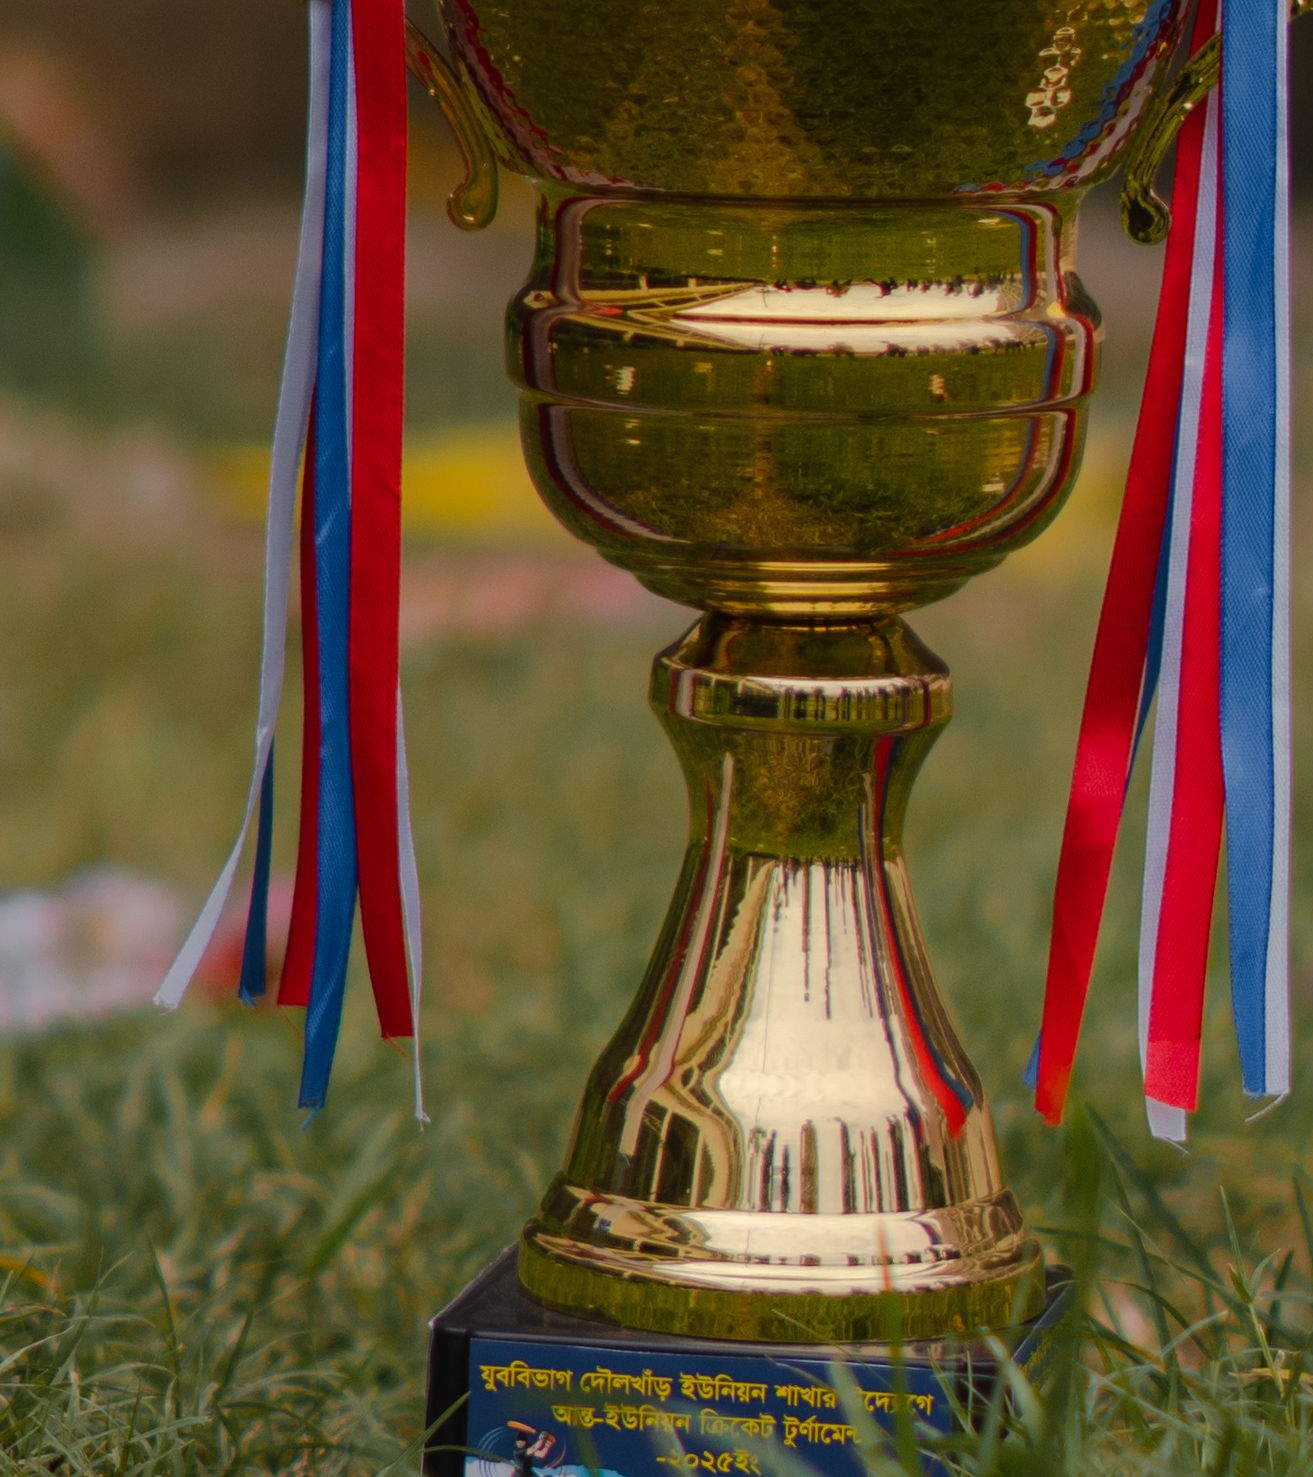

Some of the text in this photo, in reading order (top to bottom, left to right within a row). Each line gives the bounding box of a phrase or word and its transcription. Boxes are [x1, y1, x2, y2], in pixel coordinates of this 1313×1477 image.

[479, 1360, 573, 1391] যুববিভাগ
[580, 1365, 673, 1401] দৌলখাঁড়
[679, 1371, 767, 1404] ইউনিয়ন
[774, 1383, 838, 1409] শাখার
[699, 1407, 776, 1438] ক্রিকেট
